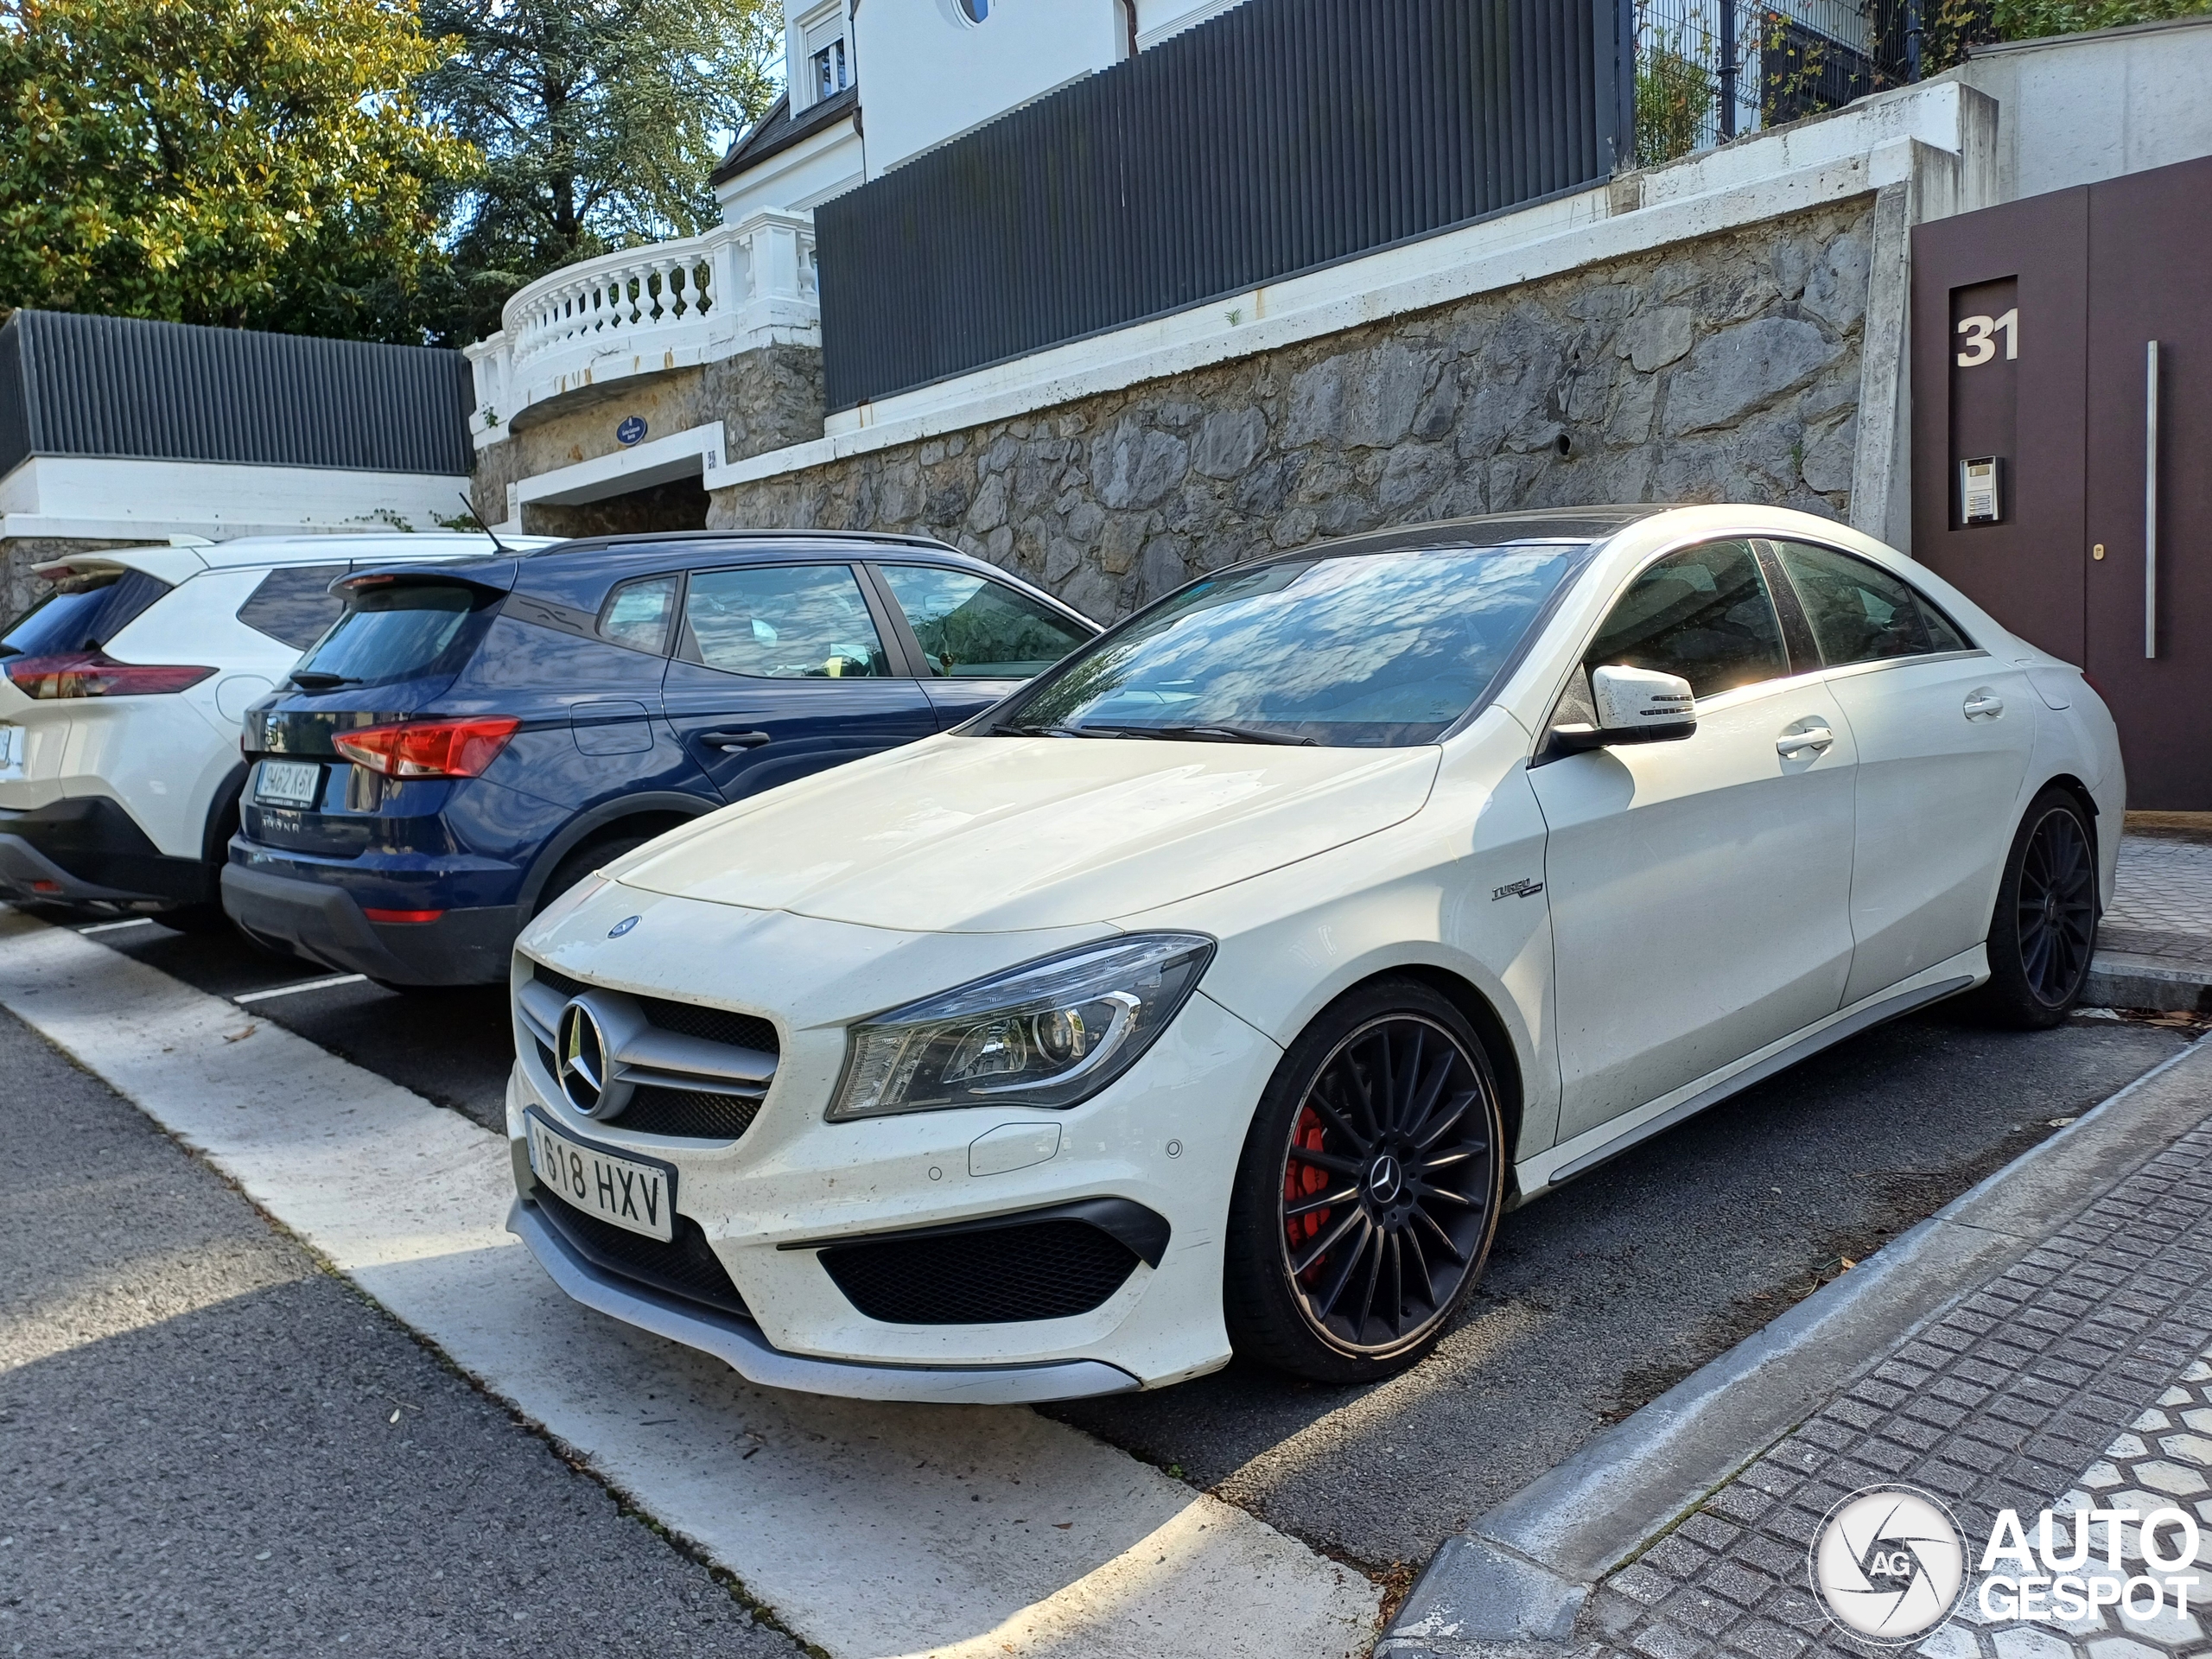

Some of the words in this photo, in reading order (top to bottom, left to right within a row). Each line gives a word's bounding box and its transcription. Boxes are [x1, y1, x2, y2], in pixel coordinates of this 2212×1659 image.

[1958, 308, 2018, 366] 31
[1492, 878, 1530, 898] TURBO
[536, 1127, 587, 1199] 1618
[594, 1160, 658, 1226] HXV
